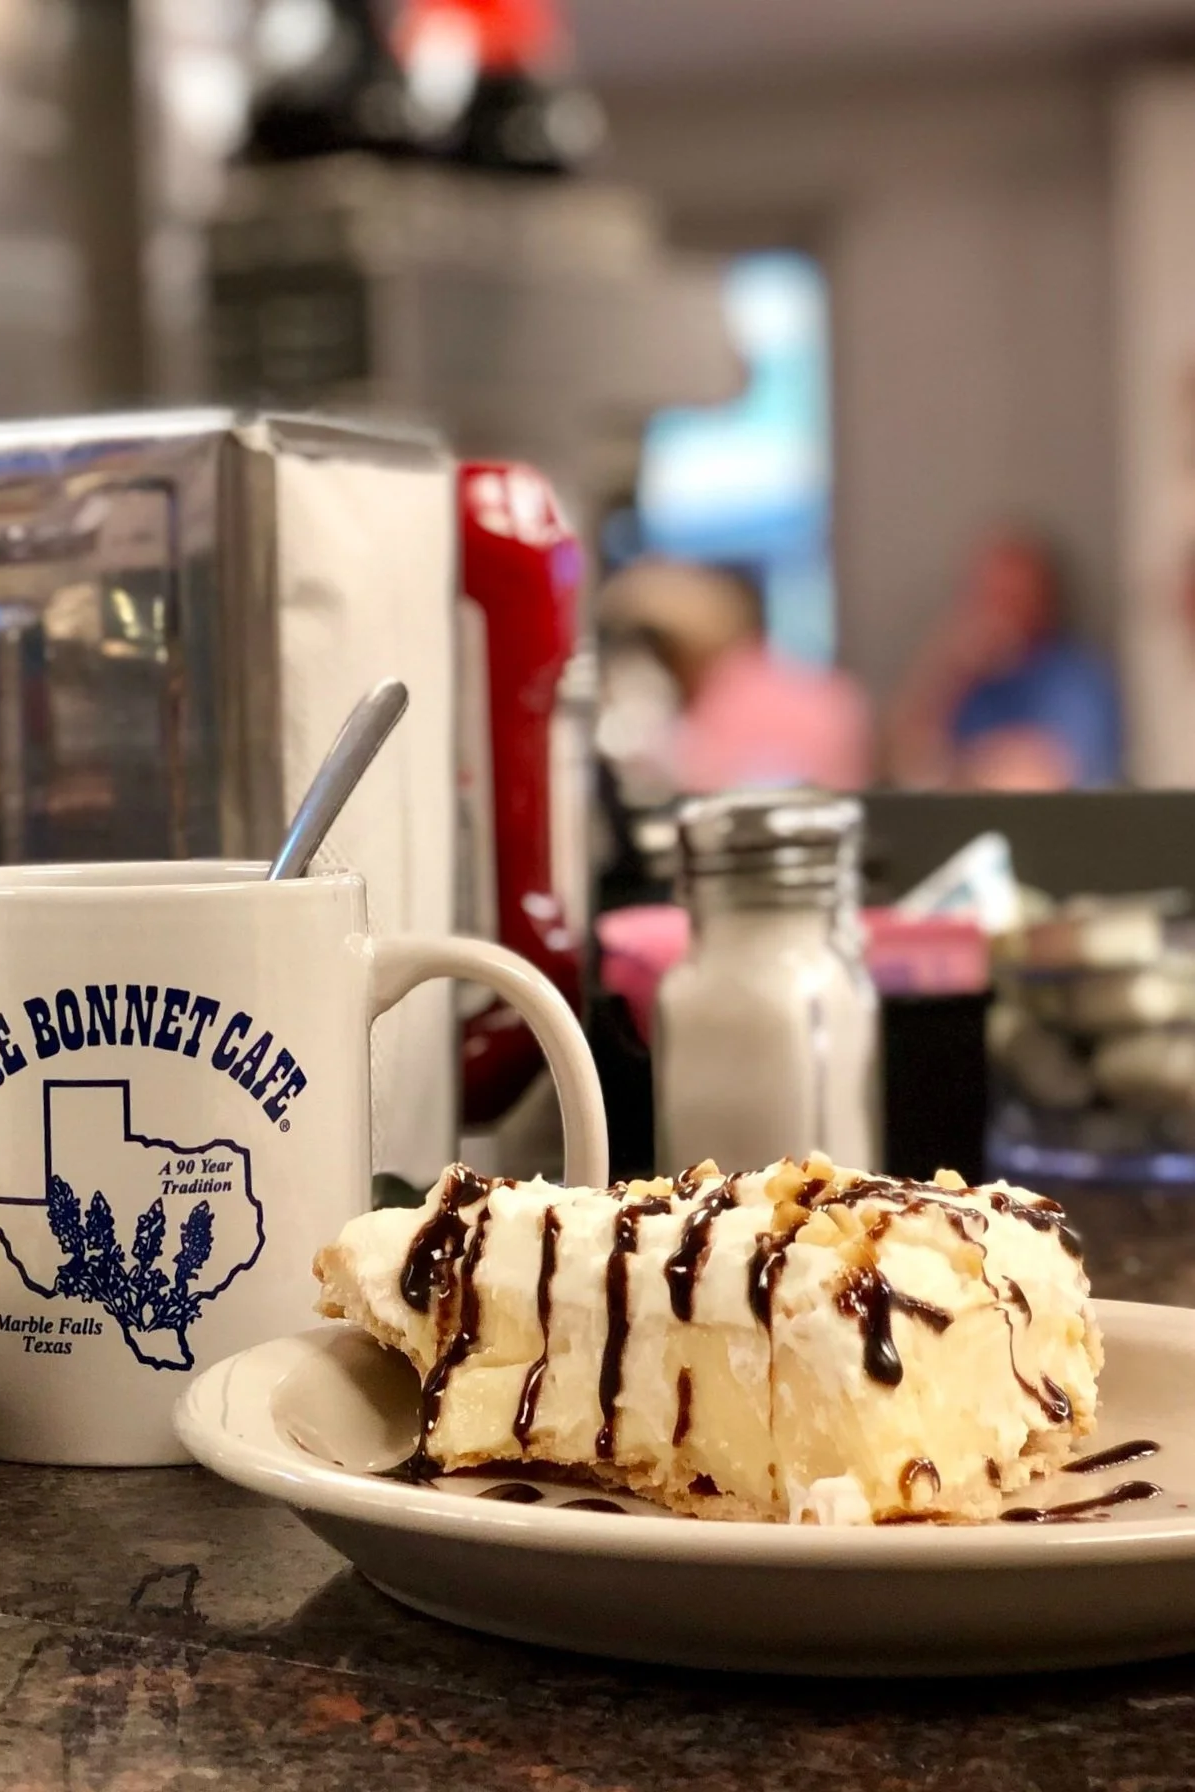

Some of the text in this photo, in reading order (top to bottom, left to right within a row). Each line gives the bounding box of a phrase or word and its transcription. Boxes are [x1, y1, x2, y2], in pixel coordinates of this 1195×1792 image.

[23, 984, 220, 1059] BONNET
[158, 1159, 234, 1176] A 90 Year
[162, 1178, 232, 1195] Tradition
[58, 1317, 103, 1335] Falls
[22, 1335, 72, 1355] Texas
